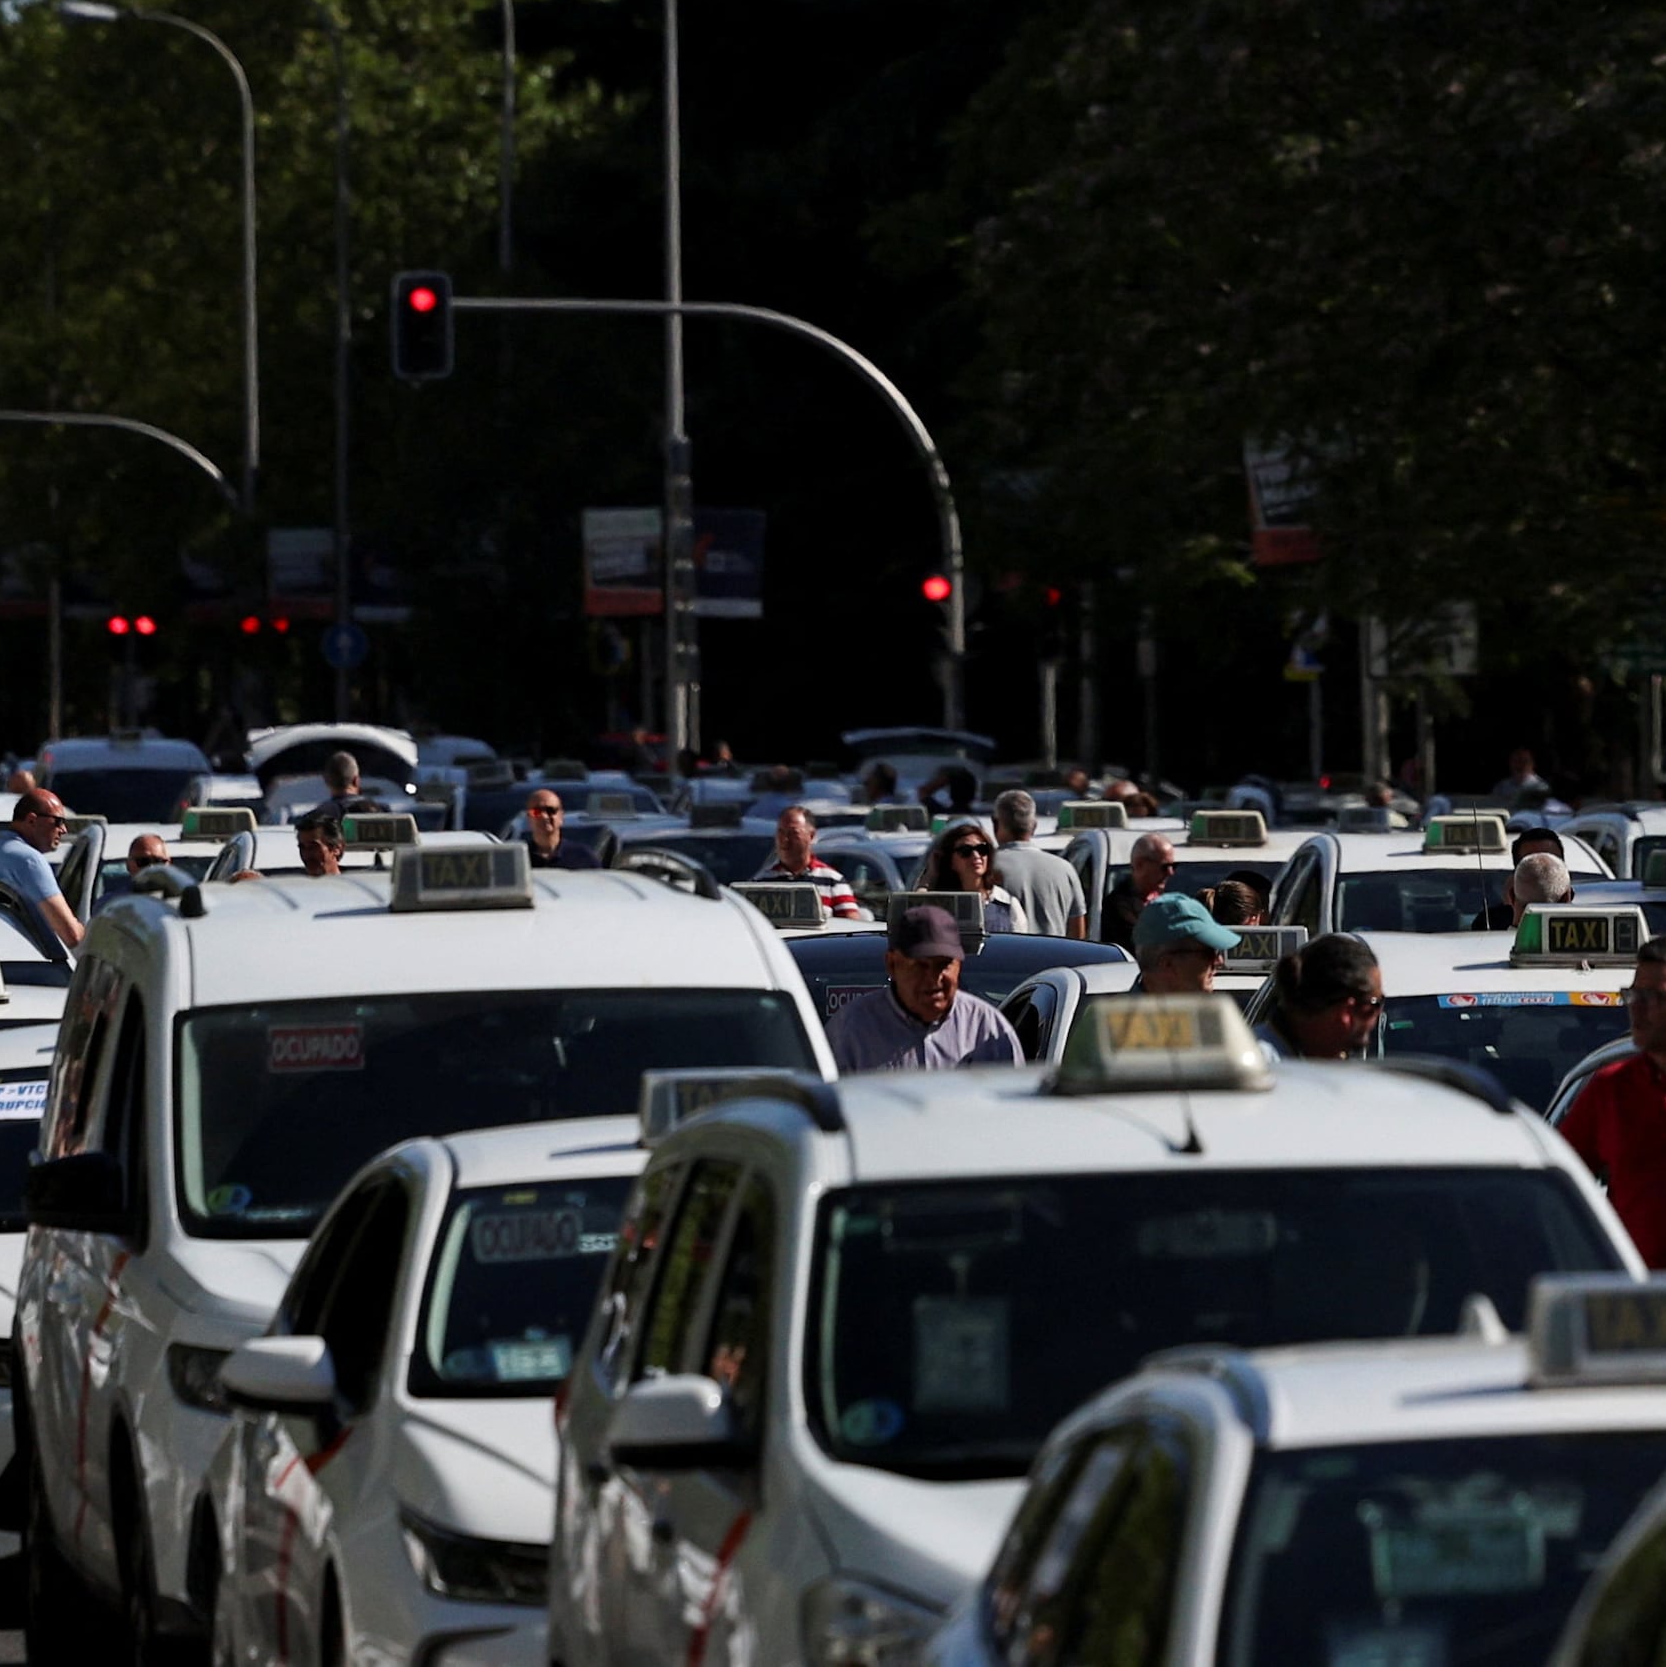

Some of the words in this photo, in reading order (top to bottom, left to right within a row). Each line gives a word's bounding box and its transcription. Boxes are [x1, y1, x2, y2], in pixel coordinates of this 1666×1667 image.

[424, 854, 486, 885] TAXI
[1551, 921, 1606, 947] TAXI
[271, 1035, 359, 1062] OCUPADO
[18, 1084, 46, 1095] VTC
